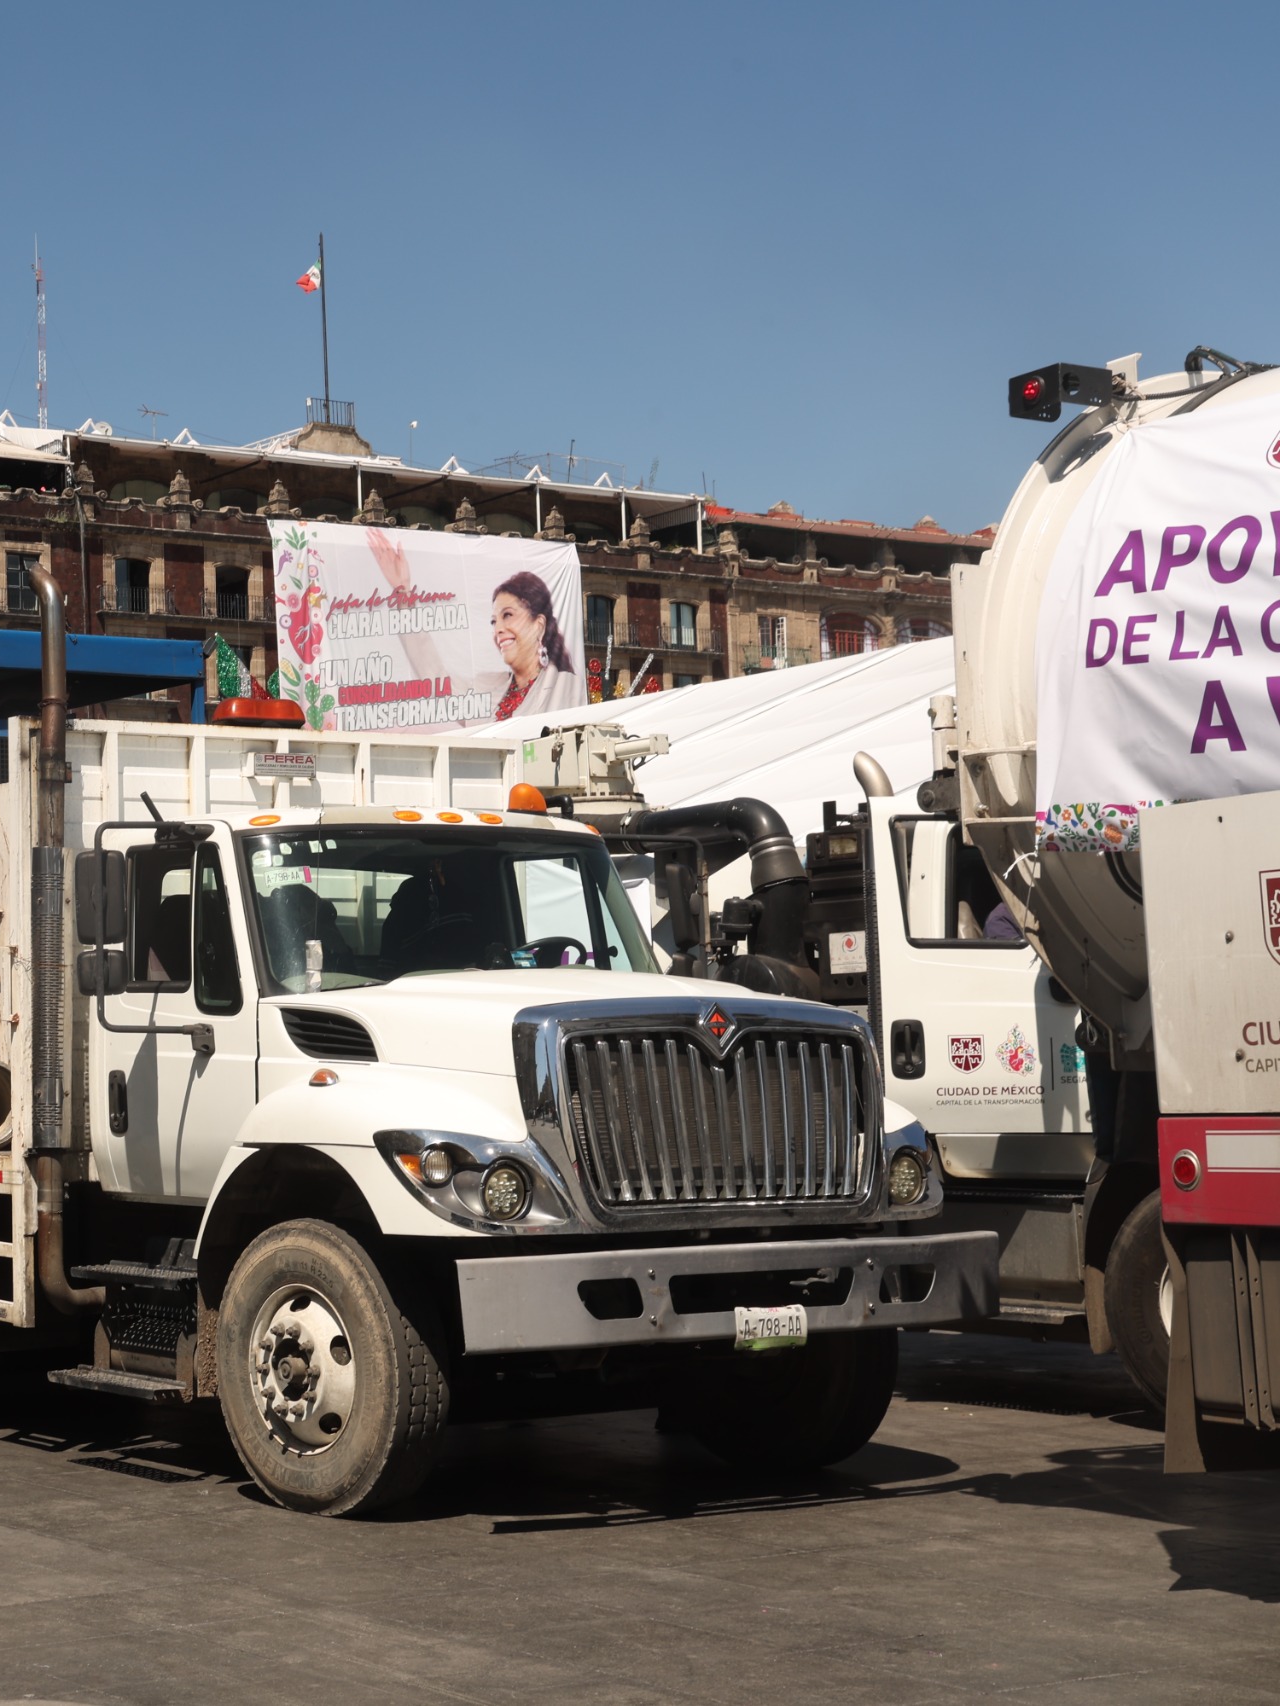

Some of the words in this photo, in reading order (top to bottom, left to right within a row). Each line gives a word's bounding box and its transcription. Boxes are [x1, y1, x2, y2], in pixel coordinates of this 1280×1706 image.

[1094, 511, 1280, 597] APO
[326, 593, 364, 621] jefa
[366, 588, 385, 611] de
[327, 610, 384, 640] CLARA
[388, 604, 469, 635] BRUGADA
[1085, 613, 1158, 668] DE
[1168, 605, 1243, 661] LA
[319, 659, 349, 689] ¡UN
[354, 651, 392, 685] AÑO
[338, 679, 432, 706] CONSOLIDANDO
[435, 676, 452, 697] LA
[333, 688, 492, 731] TRANSFORMACIÓN!
[1190, 680, 1247, 754] A
[264, 755, 314, 764] PEREA
[1245, 1058, 1280, 1073] CAPI
[936, 1087, 979, 1097] CIUDAD
[982, 1087, 998, 1096] DE
[1000, 1084, 1045, 1096] MÉXICO
[743, 1315, 802, 1339] A-798-AA
